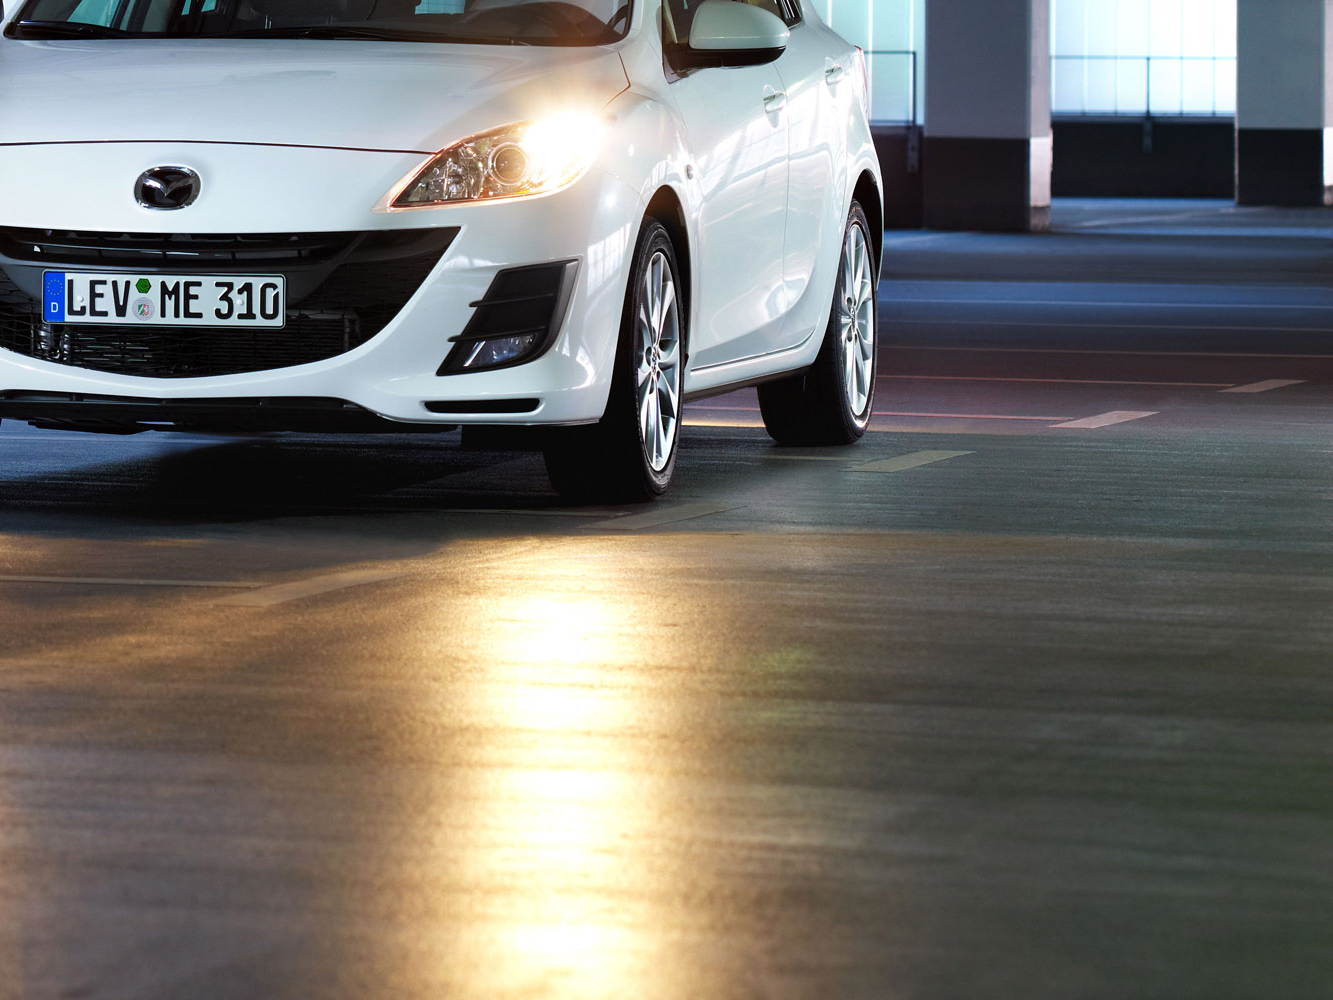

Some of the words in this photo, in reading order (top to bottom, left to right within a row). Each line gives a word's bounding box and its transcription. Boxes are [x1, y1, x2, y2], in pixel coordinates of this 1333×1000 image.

[51, 302, 59, 313] D
[67, 279, 130, 317] LEV
[160, 281, 203, 318] ME
[214, 282, 279, 320] 310
